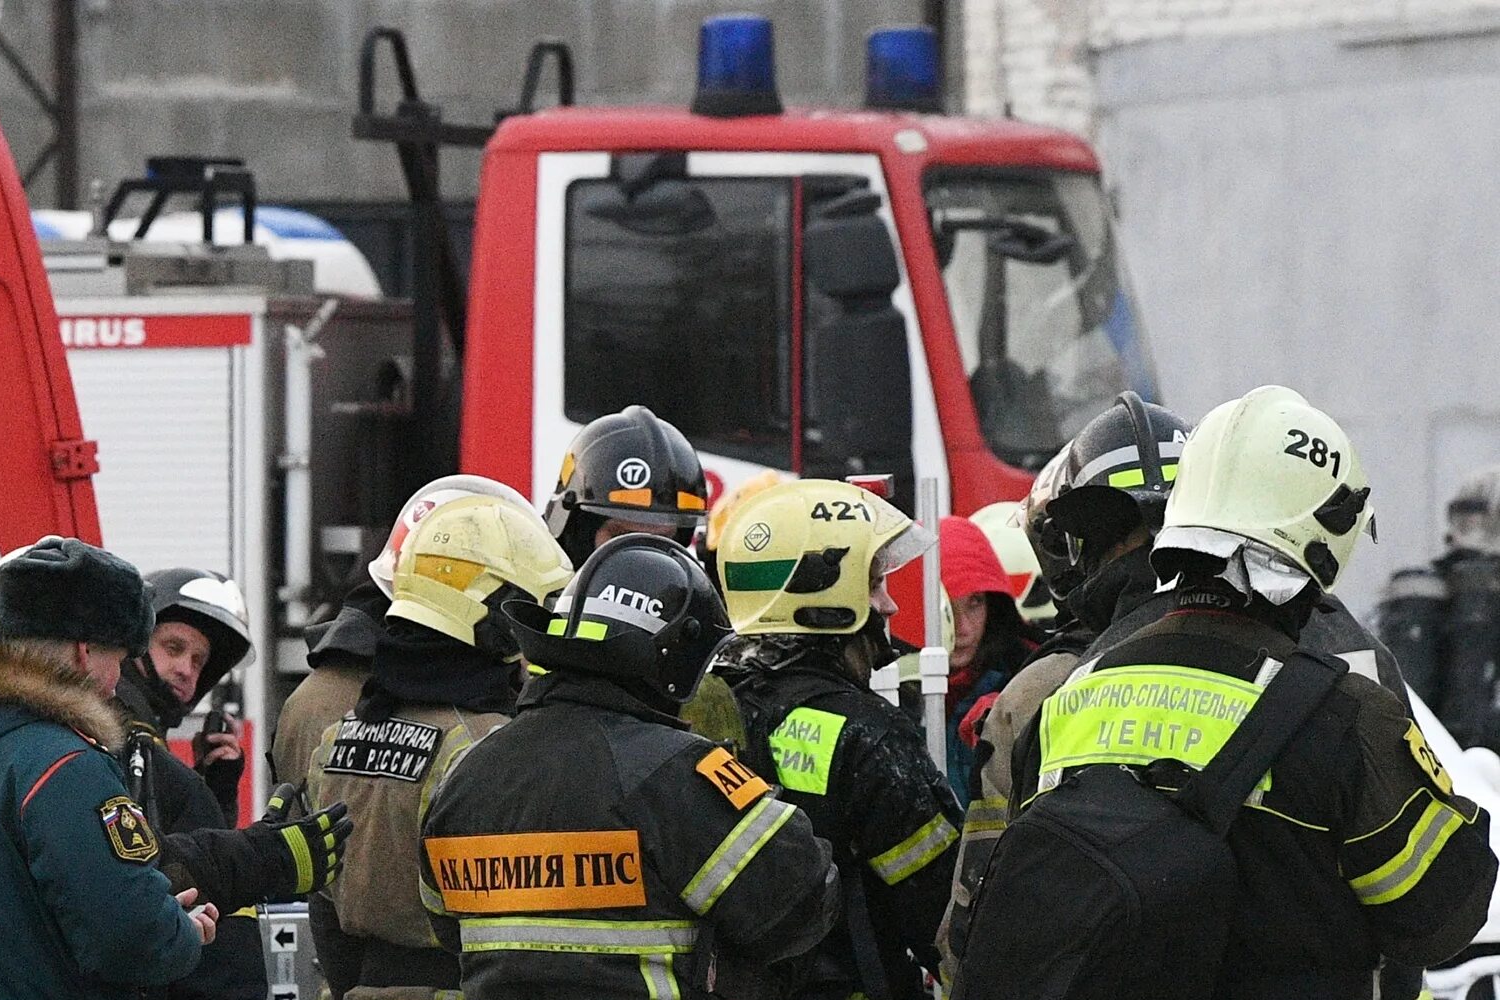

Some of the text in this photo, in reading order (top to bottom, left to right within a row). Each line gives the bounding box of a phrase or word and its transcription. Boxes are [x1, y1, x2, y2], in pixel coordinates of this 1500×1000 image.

[1284, 428, 1341, 479] 281
[622, 464, 644, 483] 17
[811, 501, 871, 522] 421
[433, 531, 451, 545] 69
[597, 584, 664, 618] АГПС
[1179, 592, 1231, 608] Canon
[388, 721, 438, 752] ОХРАНА
[1097, 719, 1203, 753] ЦЕНТР
[440, 853, 638, 899] АКАДЕМИЯ ГПС
